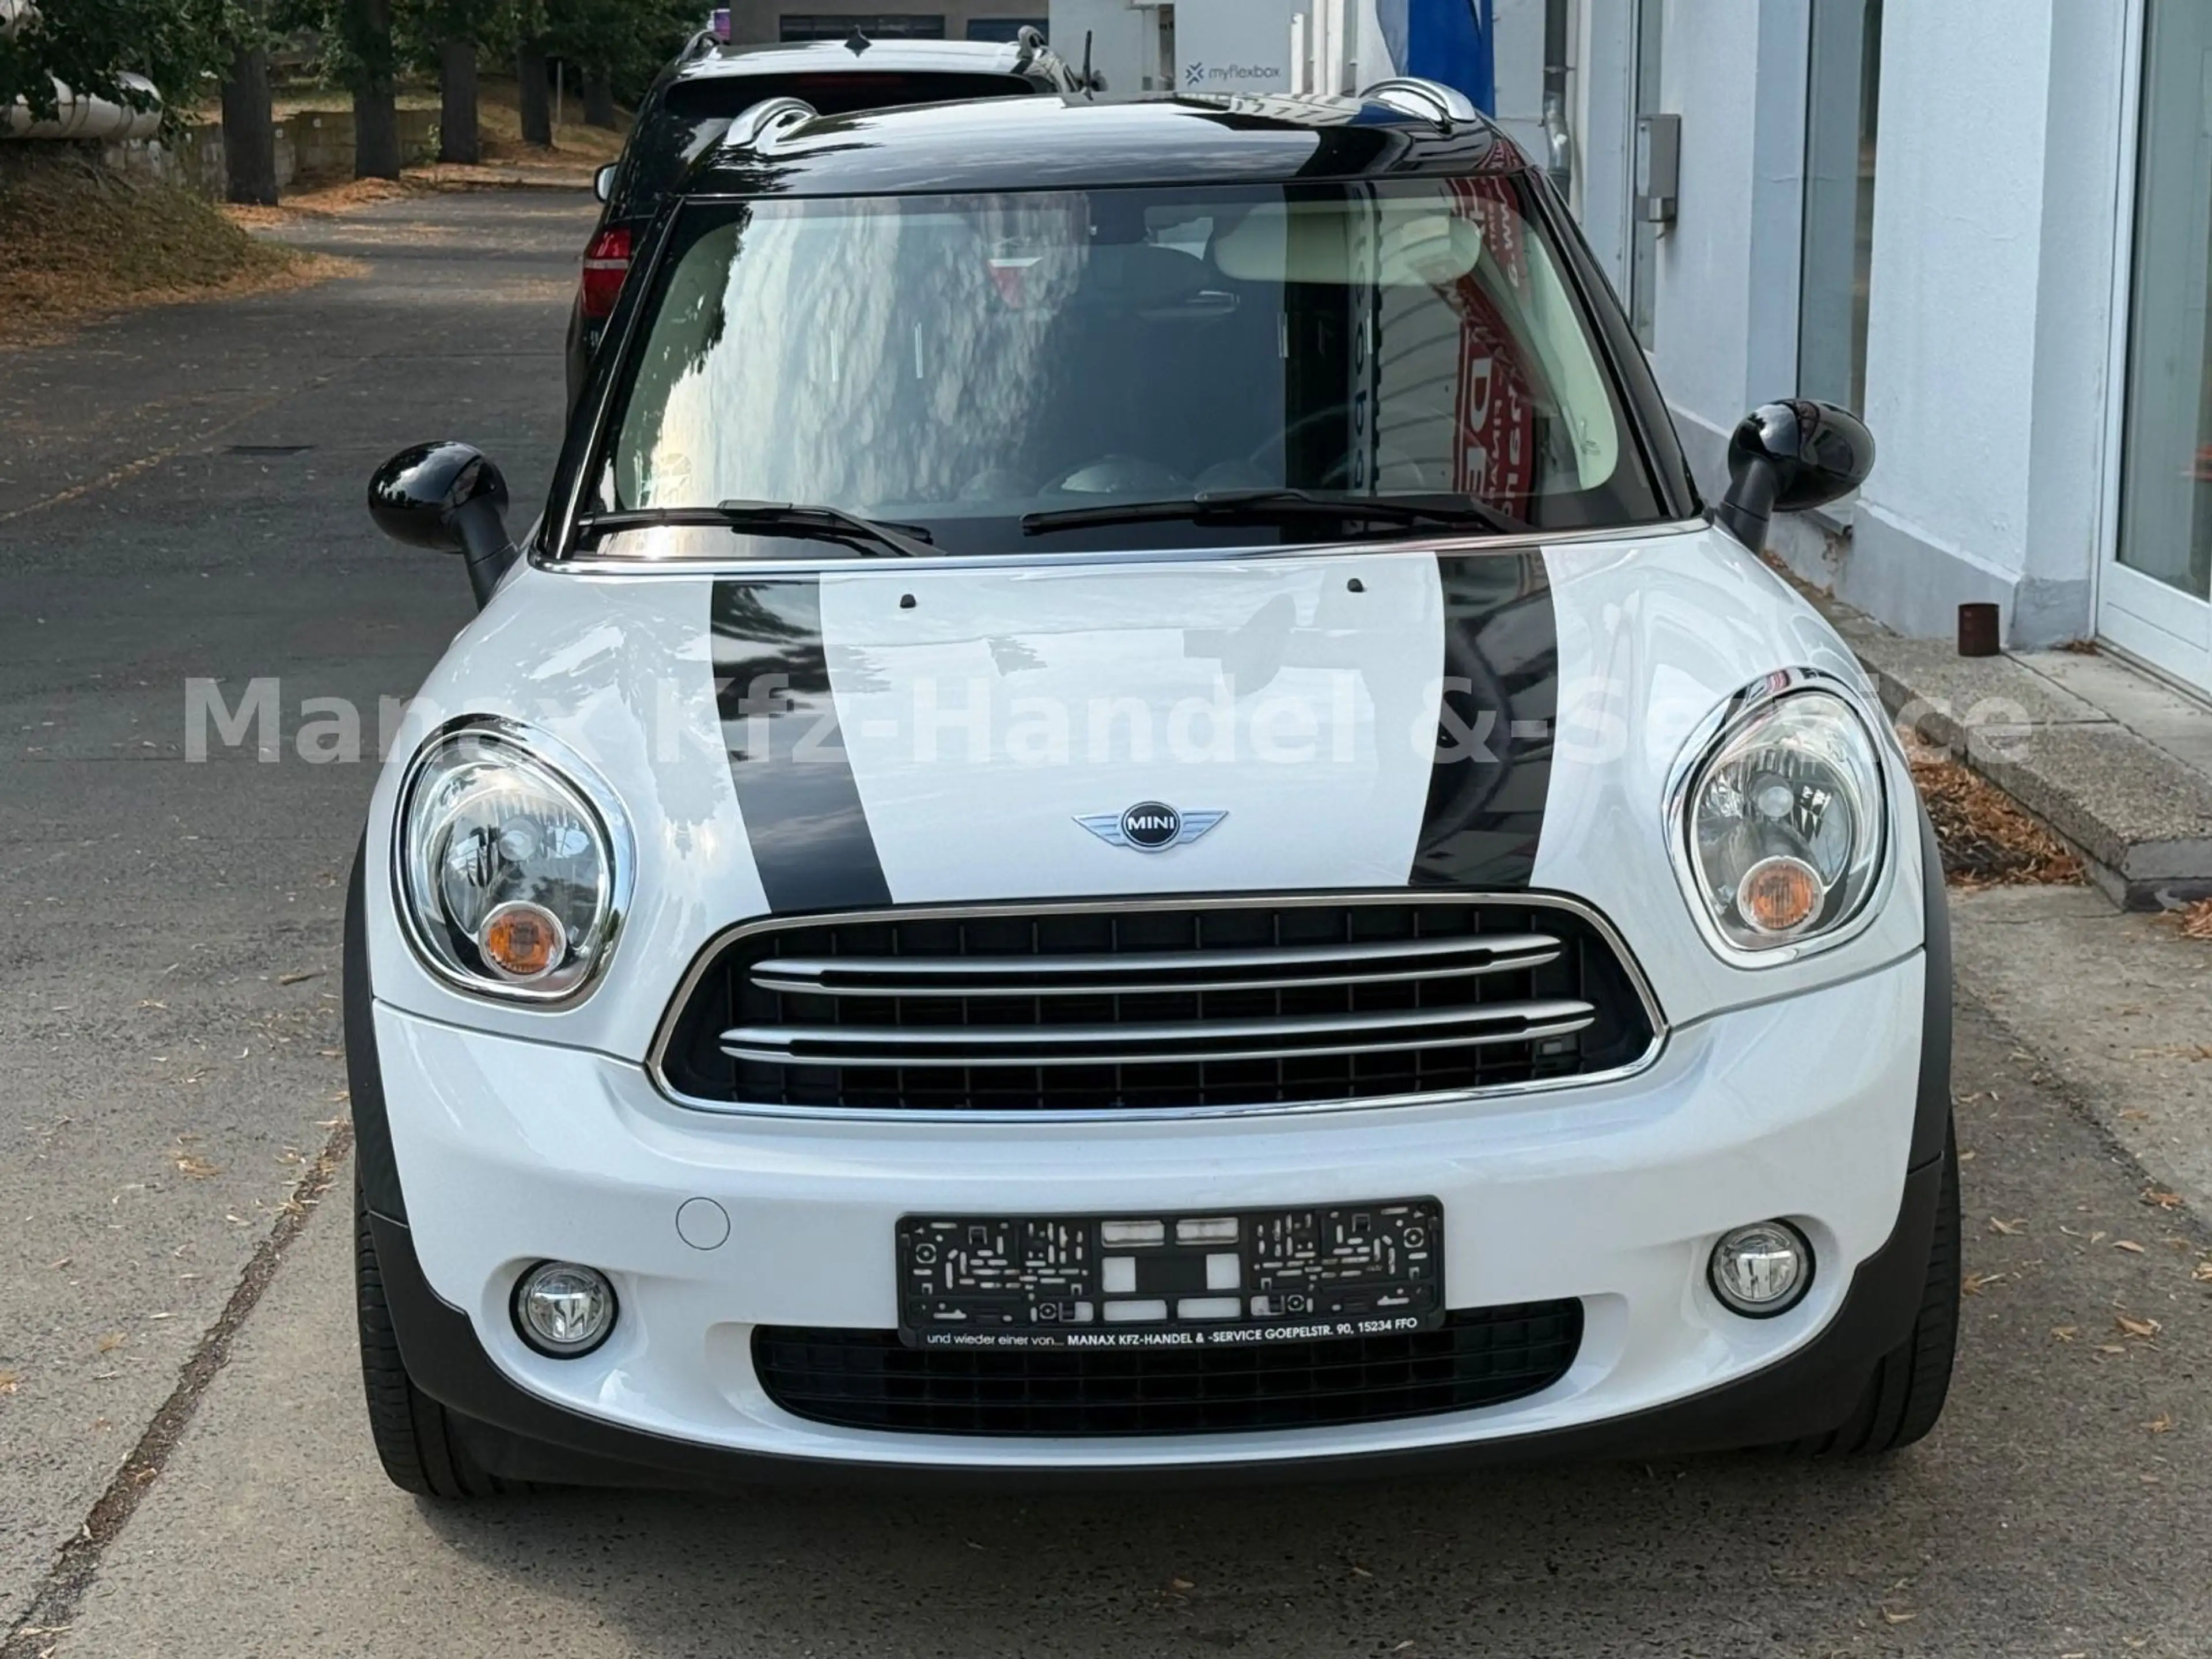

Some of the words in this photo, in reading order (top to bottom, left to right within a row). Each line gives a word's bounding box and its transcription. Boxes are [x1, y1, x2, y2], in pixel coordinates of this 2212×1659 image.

[1209, 63, 1281, 81] myflexbox
[1127, 815, 1175, 831] MINI
[926, 1332, 951, 1344] und
[953, 1332, 995, 1345] wieder
[998, 1334, 1029, 1346] einer
[1067, 1334, 1116, 1346] MANAX
[1118, 1332, 1194, 1346] KFZ-HANDEL
[1195, 1332, 1205, 1344] &
[1264, 1324, 1334, 1340] GOEPELSTR.
[1336, 1323, 1354, 1335] 90,
[1357, 1319, 1392, 1333] 15234
[1395, 1317, 1418, 1330] FFO
